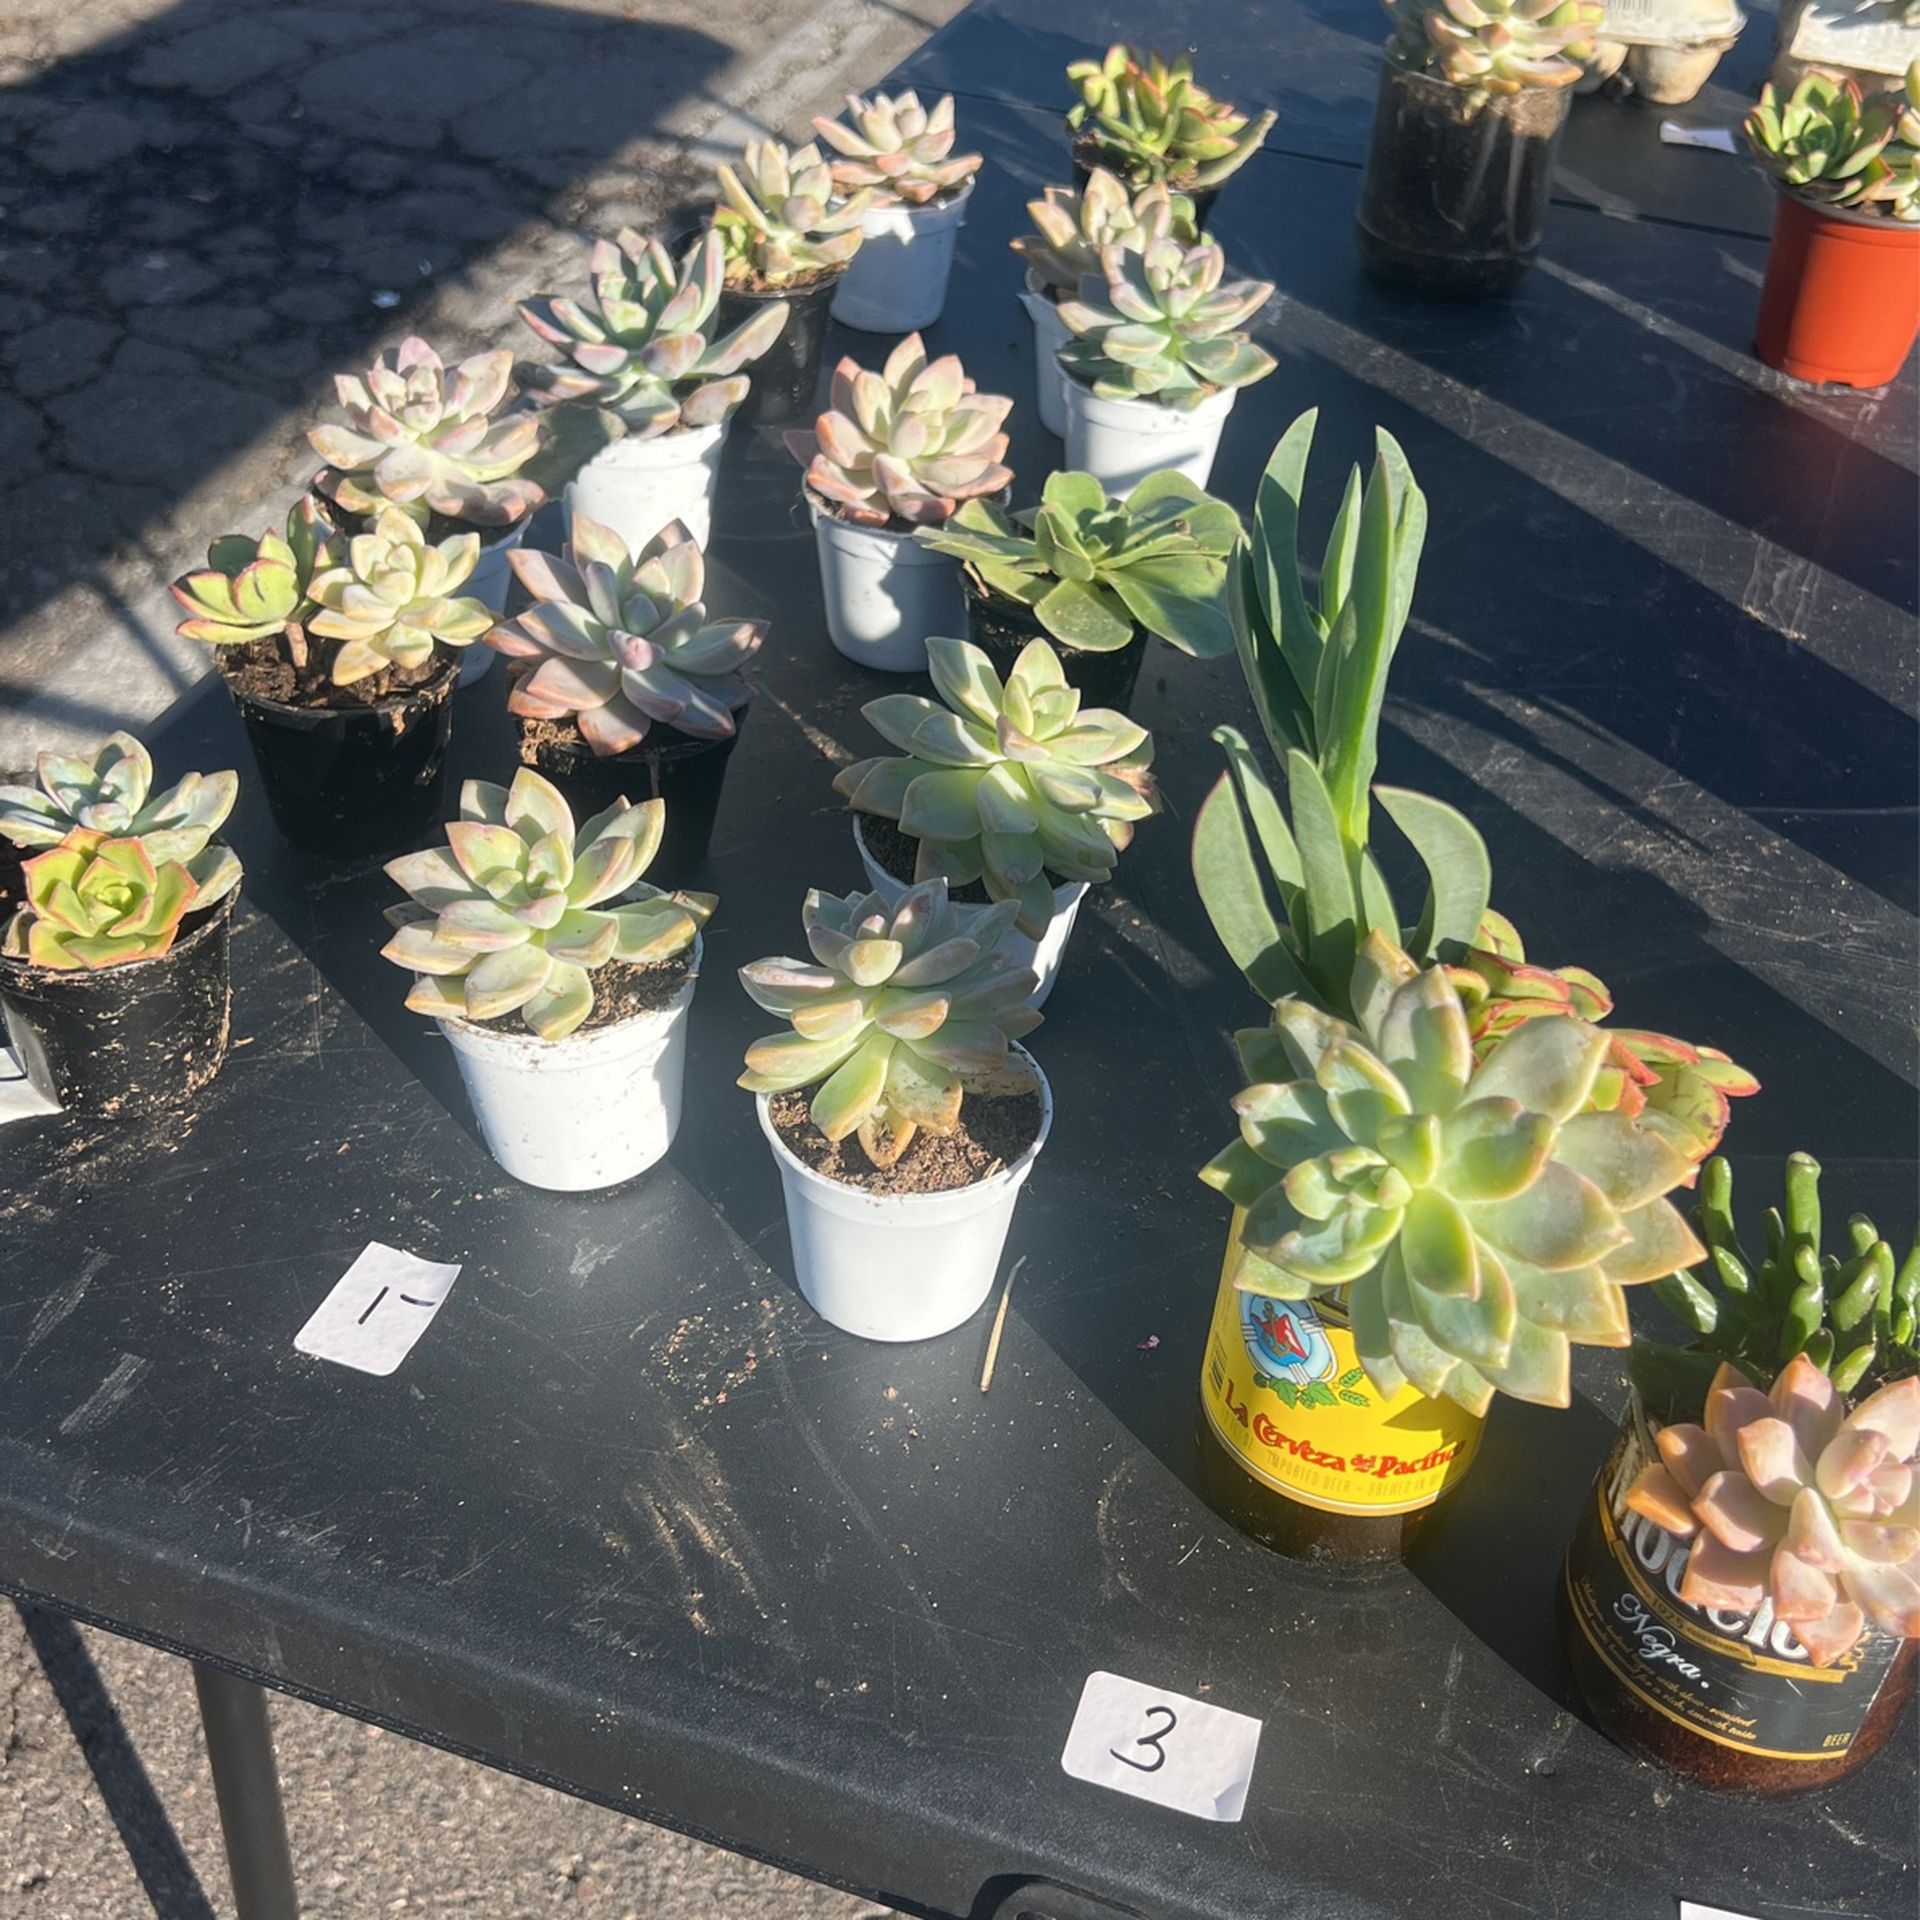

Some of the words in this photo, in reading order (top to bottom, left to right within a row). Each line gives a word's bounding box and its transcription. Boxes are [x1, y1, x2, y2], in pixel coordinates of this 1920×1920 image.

[1253, 1413, 1346, 1472] Cerveza
[1266, 1450, 1320, 1487] IMPORTED
[1323, 1475, 1351, 1493] BEER
[1651, 1600, 1685, 1632] 1925
[1109, 1705, 1178, 1773] 3
[1822, 1732, 1851, 1748] BEER
